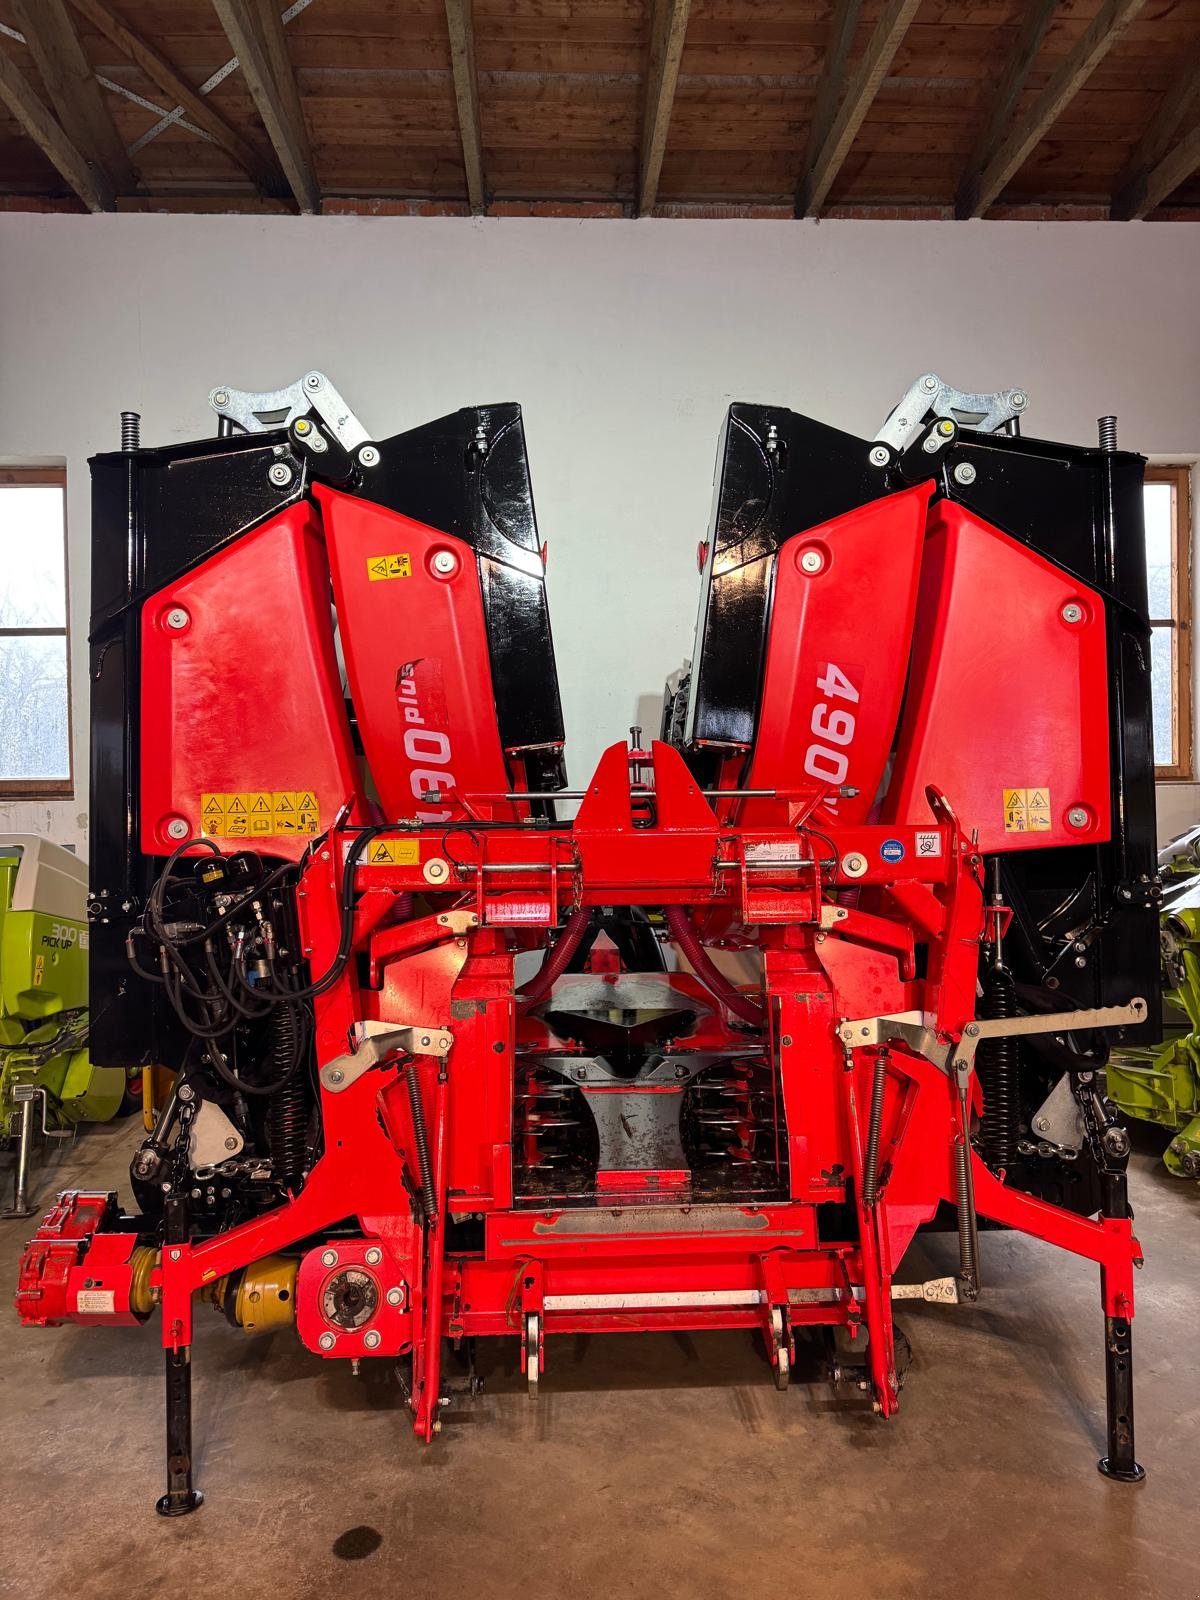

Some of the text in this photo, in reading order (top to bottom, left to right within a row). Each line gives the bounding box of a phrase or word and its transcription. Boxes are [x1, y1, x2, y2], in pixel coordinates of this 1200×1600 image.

[398, 663, 425, 725] plus
[804, 662, 860, 785] 490
[41, 935, 60, 948] PICK
[61, 939, 73, 951] UP
[51, 923, 77, 942] 300
